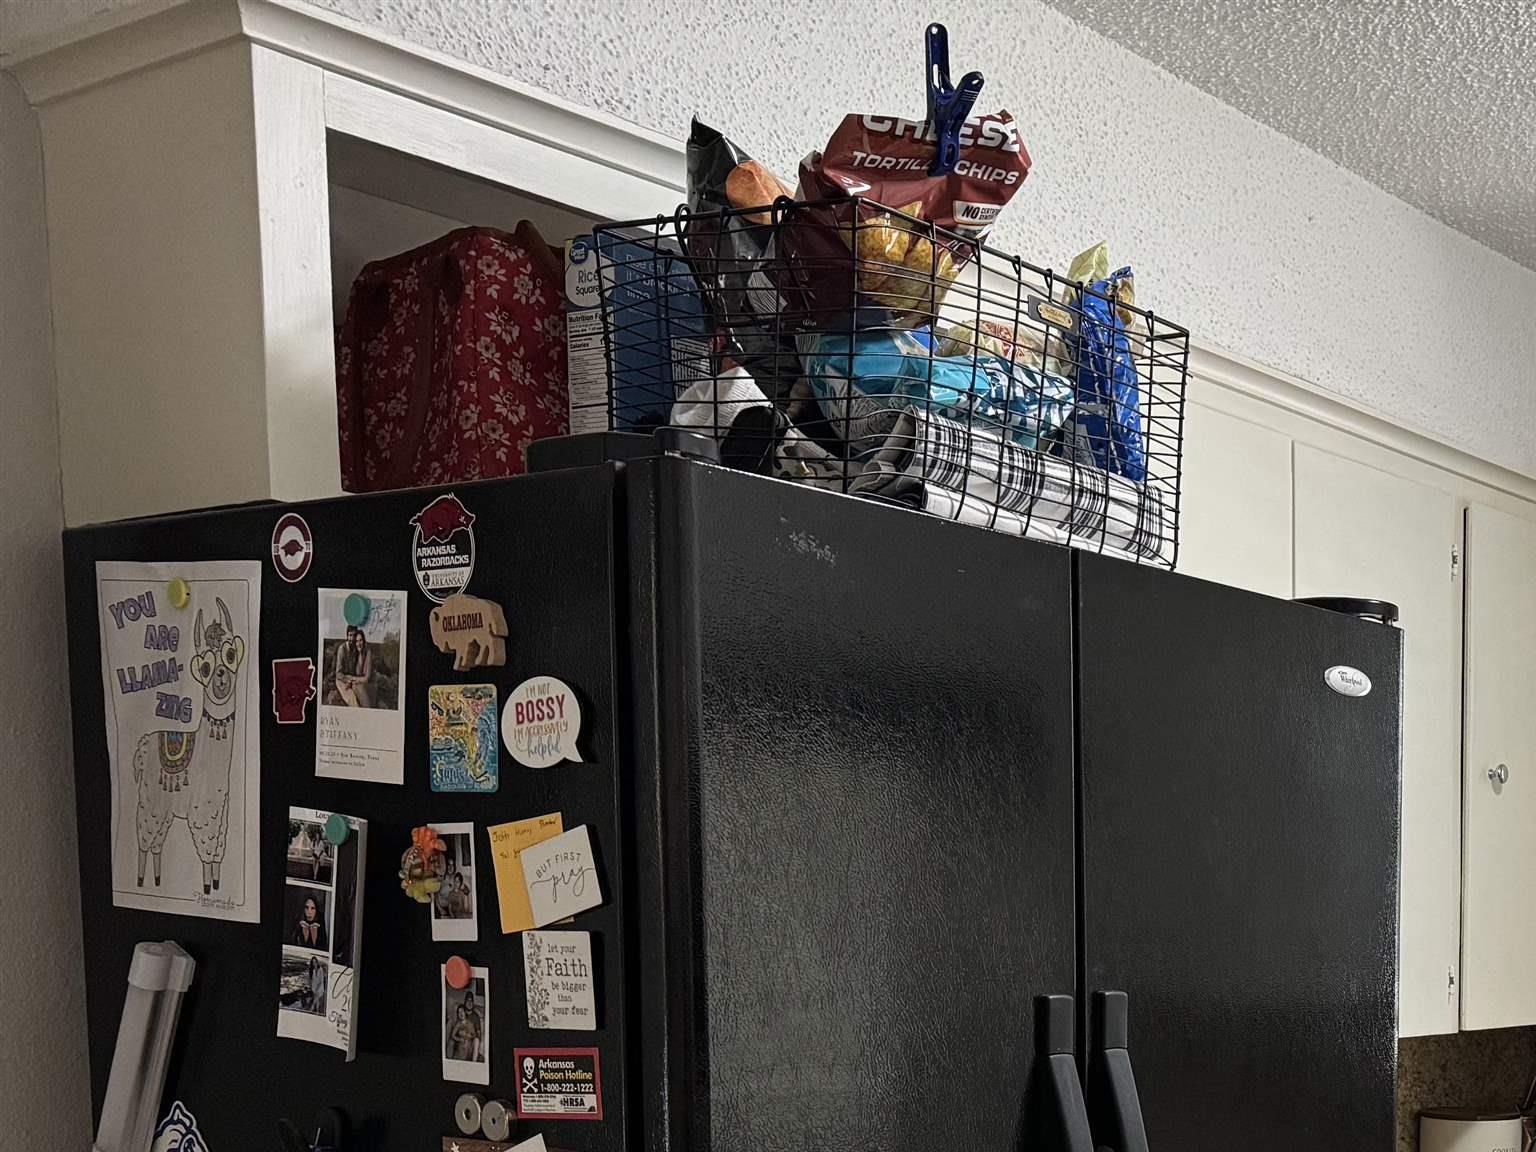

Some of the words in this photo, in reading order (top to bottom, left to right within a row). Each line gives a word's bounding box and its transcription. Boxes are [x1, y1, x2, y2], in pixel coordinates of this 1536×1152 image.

[852, 151, 934, 171] TORTILL
[954, 160, 1020, 185] CHIPS
[962, 204, 980, 219] NO
[578, 269, 599, 283] Rice
[575, 285, 601, 296] Square
[416, 544, 456, 558] ARKANSAS
[421, 554, 470, 568] RAZORBACKS
[432, 576, 465, 585] ARKANSAS
[108, 591, 157, 629] YOU
[442, 611, 484, 633] OKLAHOMA
[515, 694, 565, 725] BOSSY
[535, 858, 551, 879] BUT
[555, 851, 582, 864] FIRST
[547, 943, 558, 953] let
[560, 946, 577, 955] your
[545, 957, 588, 977] Faith
[551, 981, 560, 990] be
[561, 981, 587, 992] bigger
[551, 1007, 568, 1017] your
[571, 1006, 589, 1016] fear
[538, 1058, 575, 1069] Arkansas
[539, 1070, 564, 1080] Poison
[565, 1070, 593, 1080] Hotline
[540, 1083, 594, 1093] 1-800-222-1222
